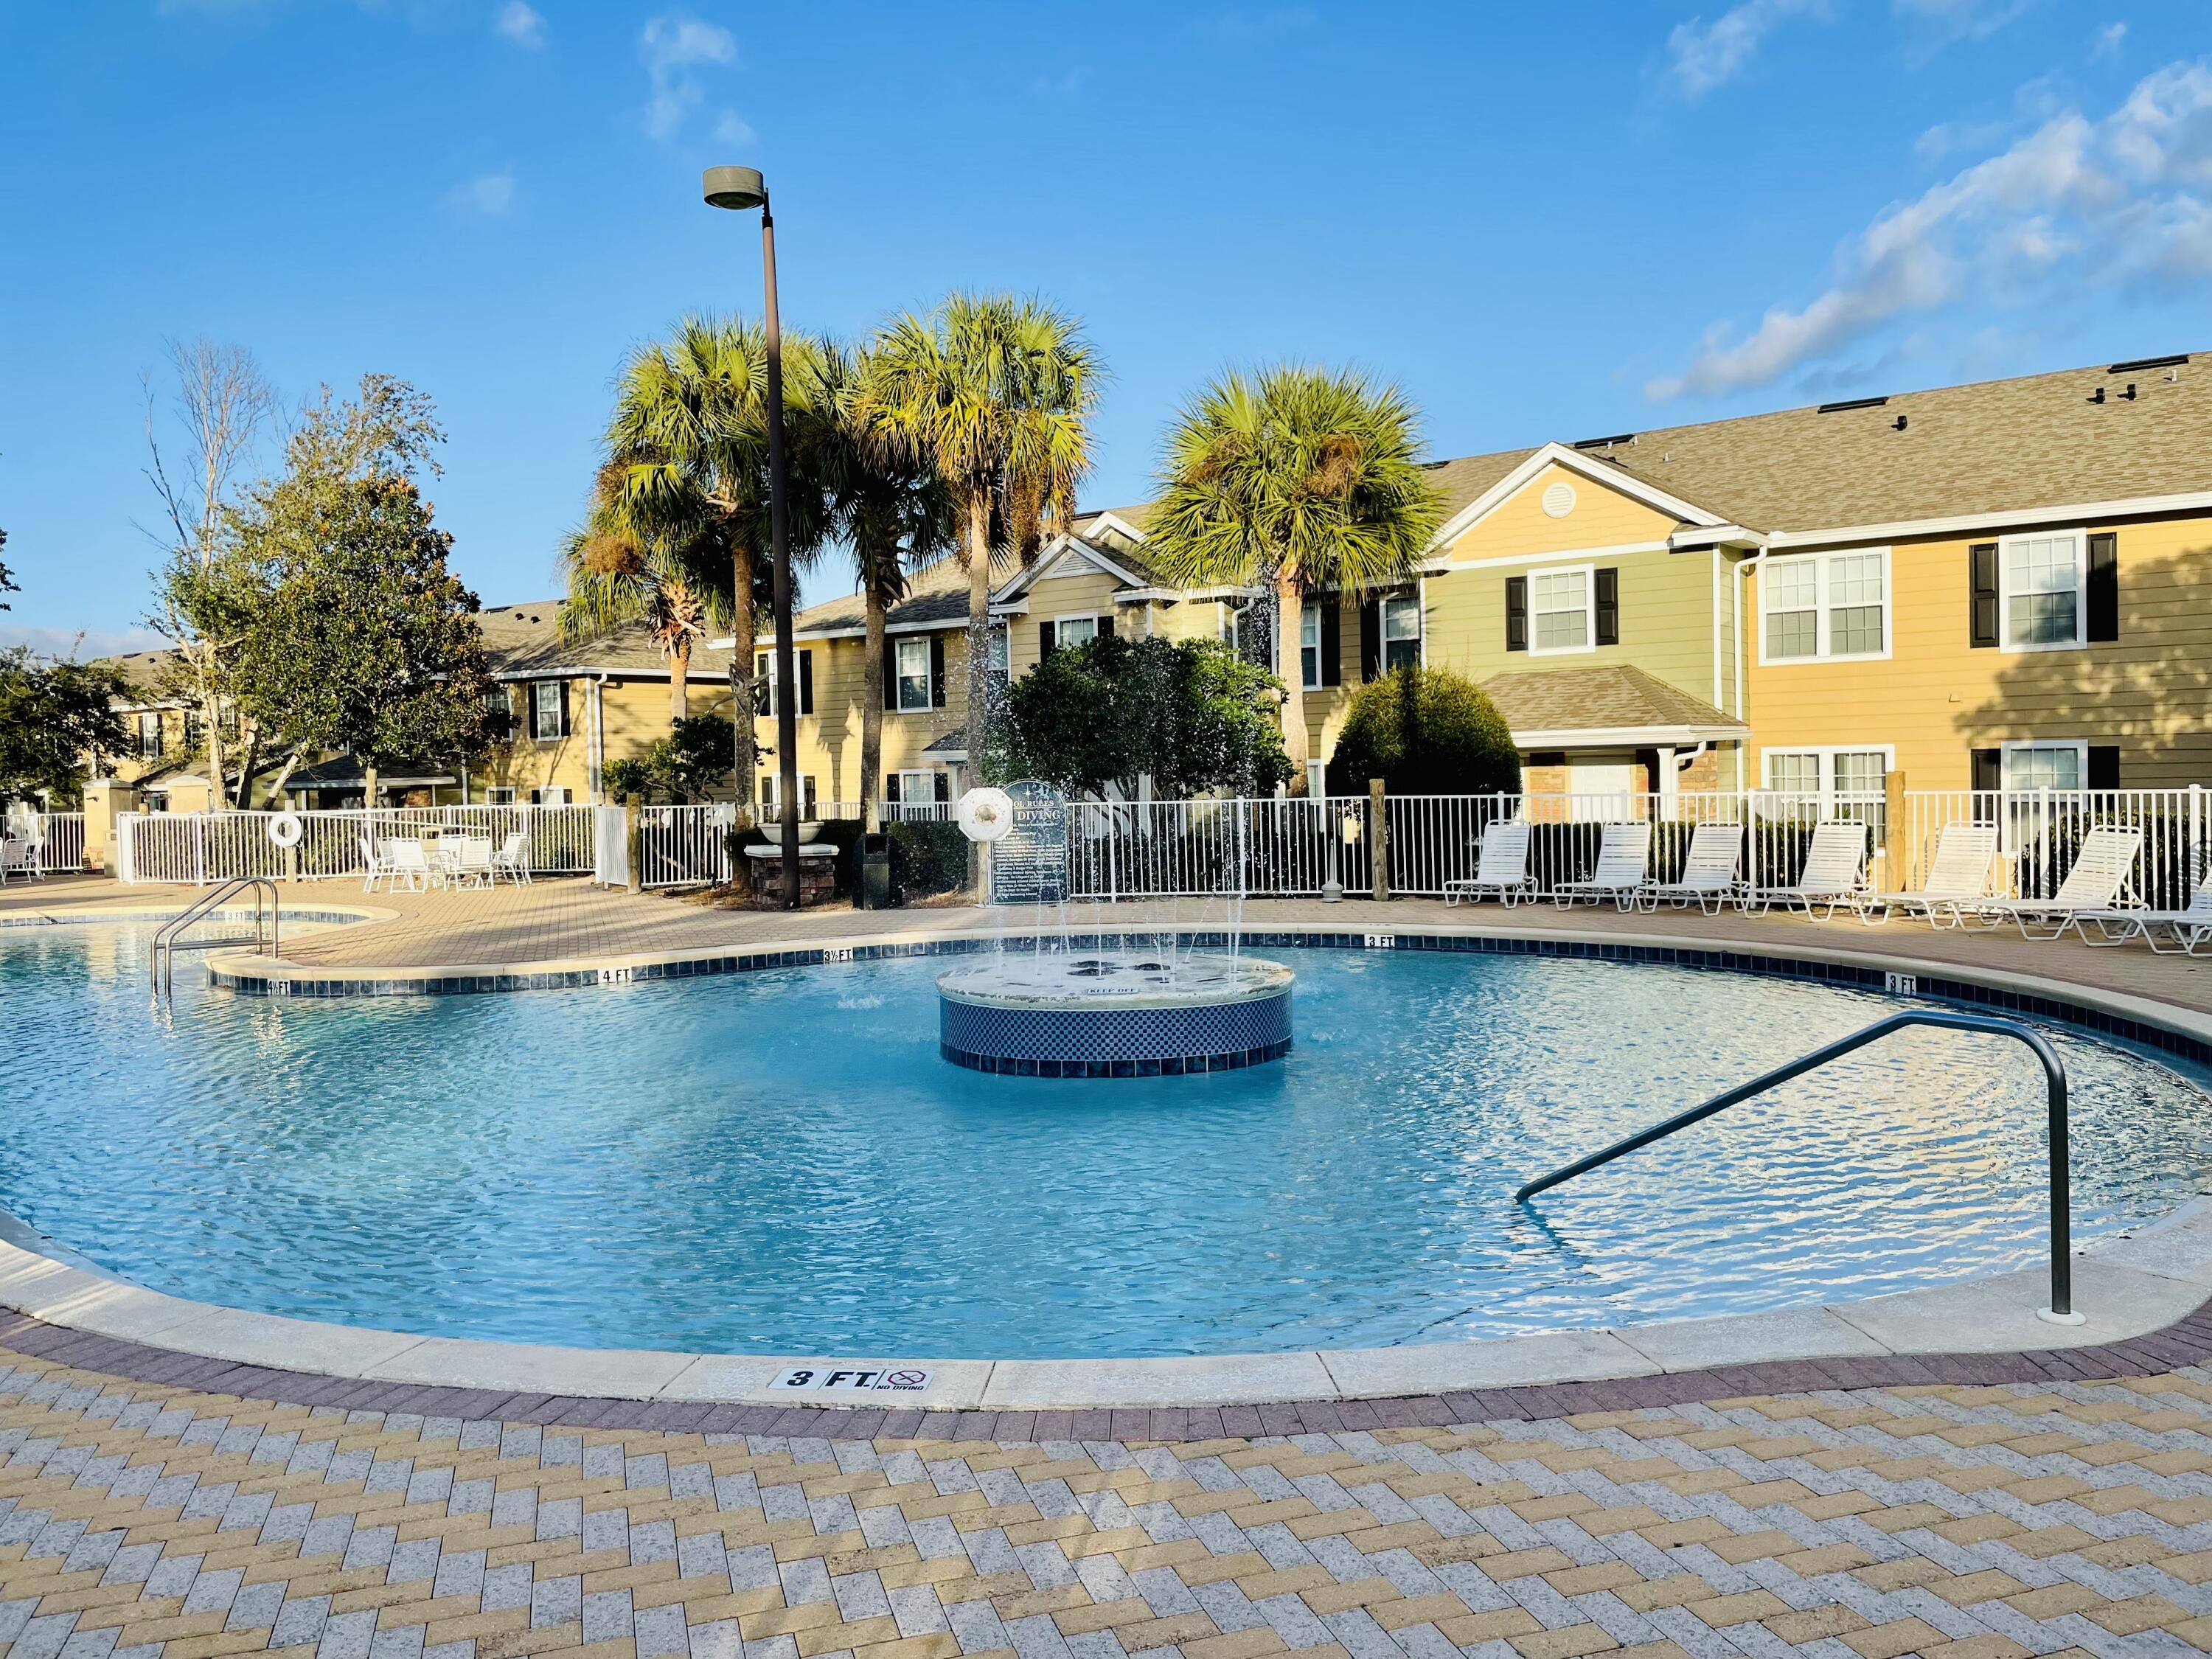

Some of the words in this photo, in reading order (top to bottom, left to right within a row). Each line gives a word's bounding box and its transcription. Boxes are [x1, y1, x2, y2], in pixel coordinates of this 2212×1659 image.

[1018, 810, 1061, 821] DIVING
[1369, 936, 1376, 947] 3
[603, 970, 611, 982] 4
[1890, 975, 1896, 989] 3
[787, 1371, 814, 1386] 3
[825, 1371, 878, 1388] FT.
